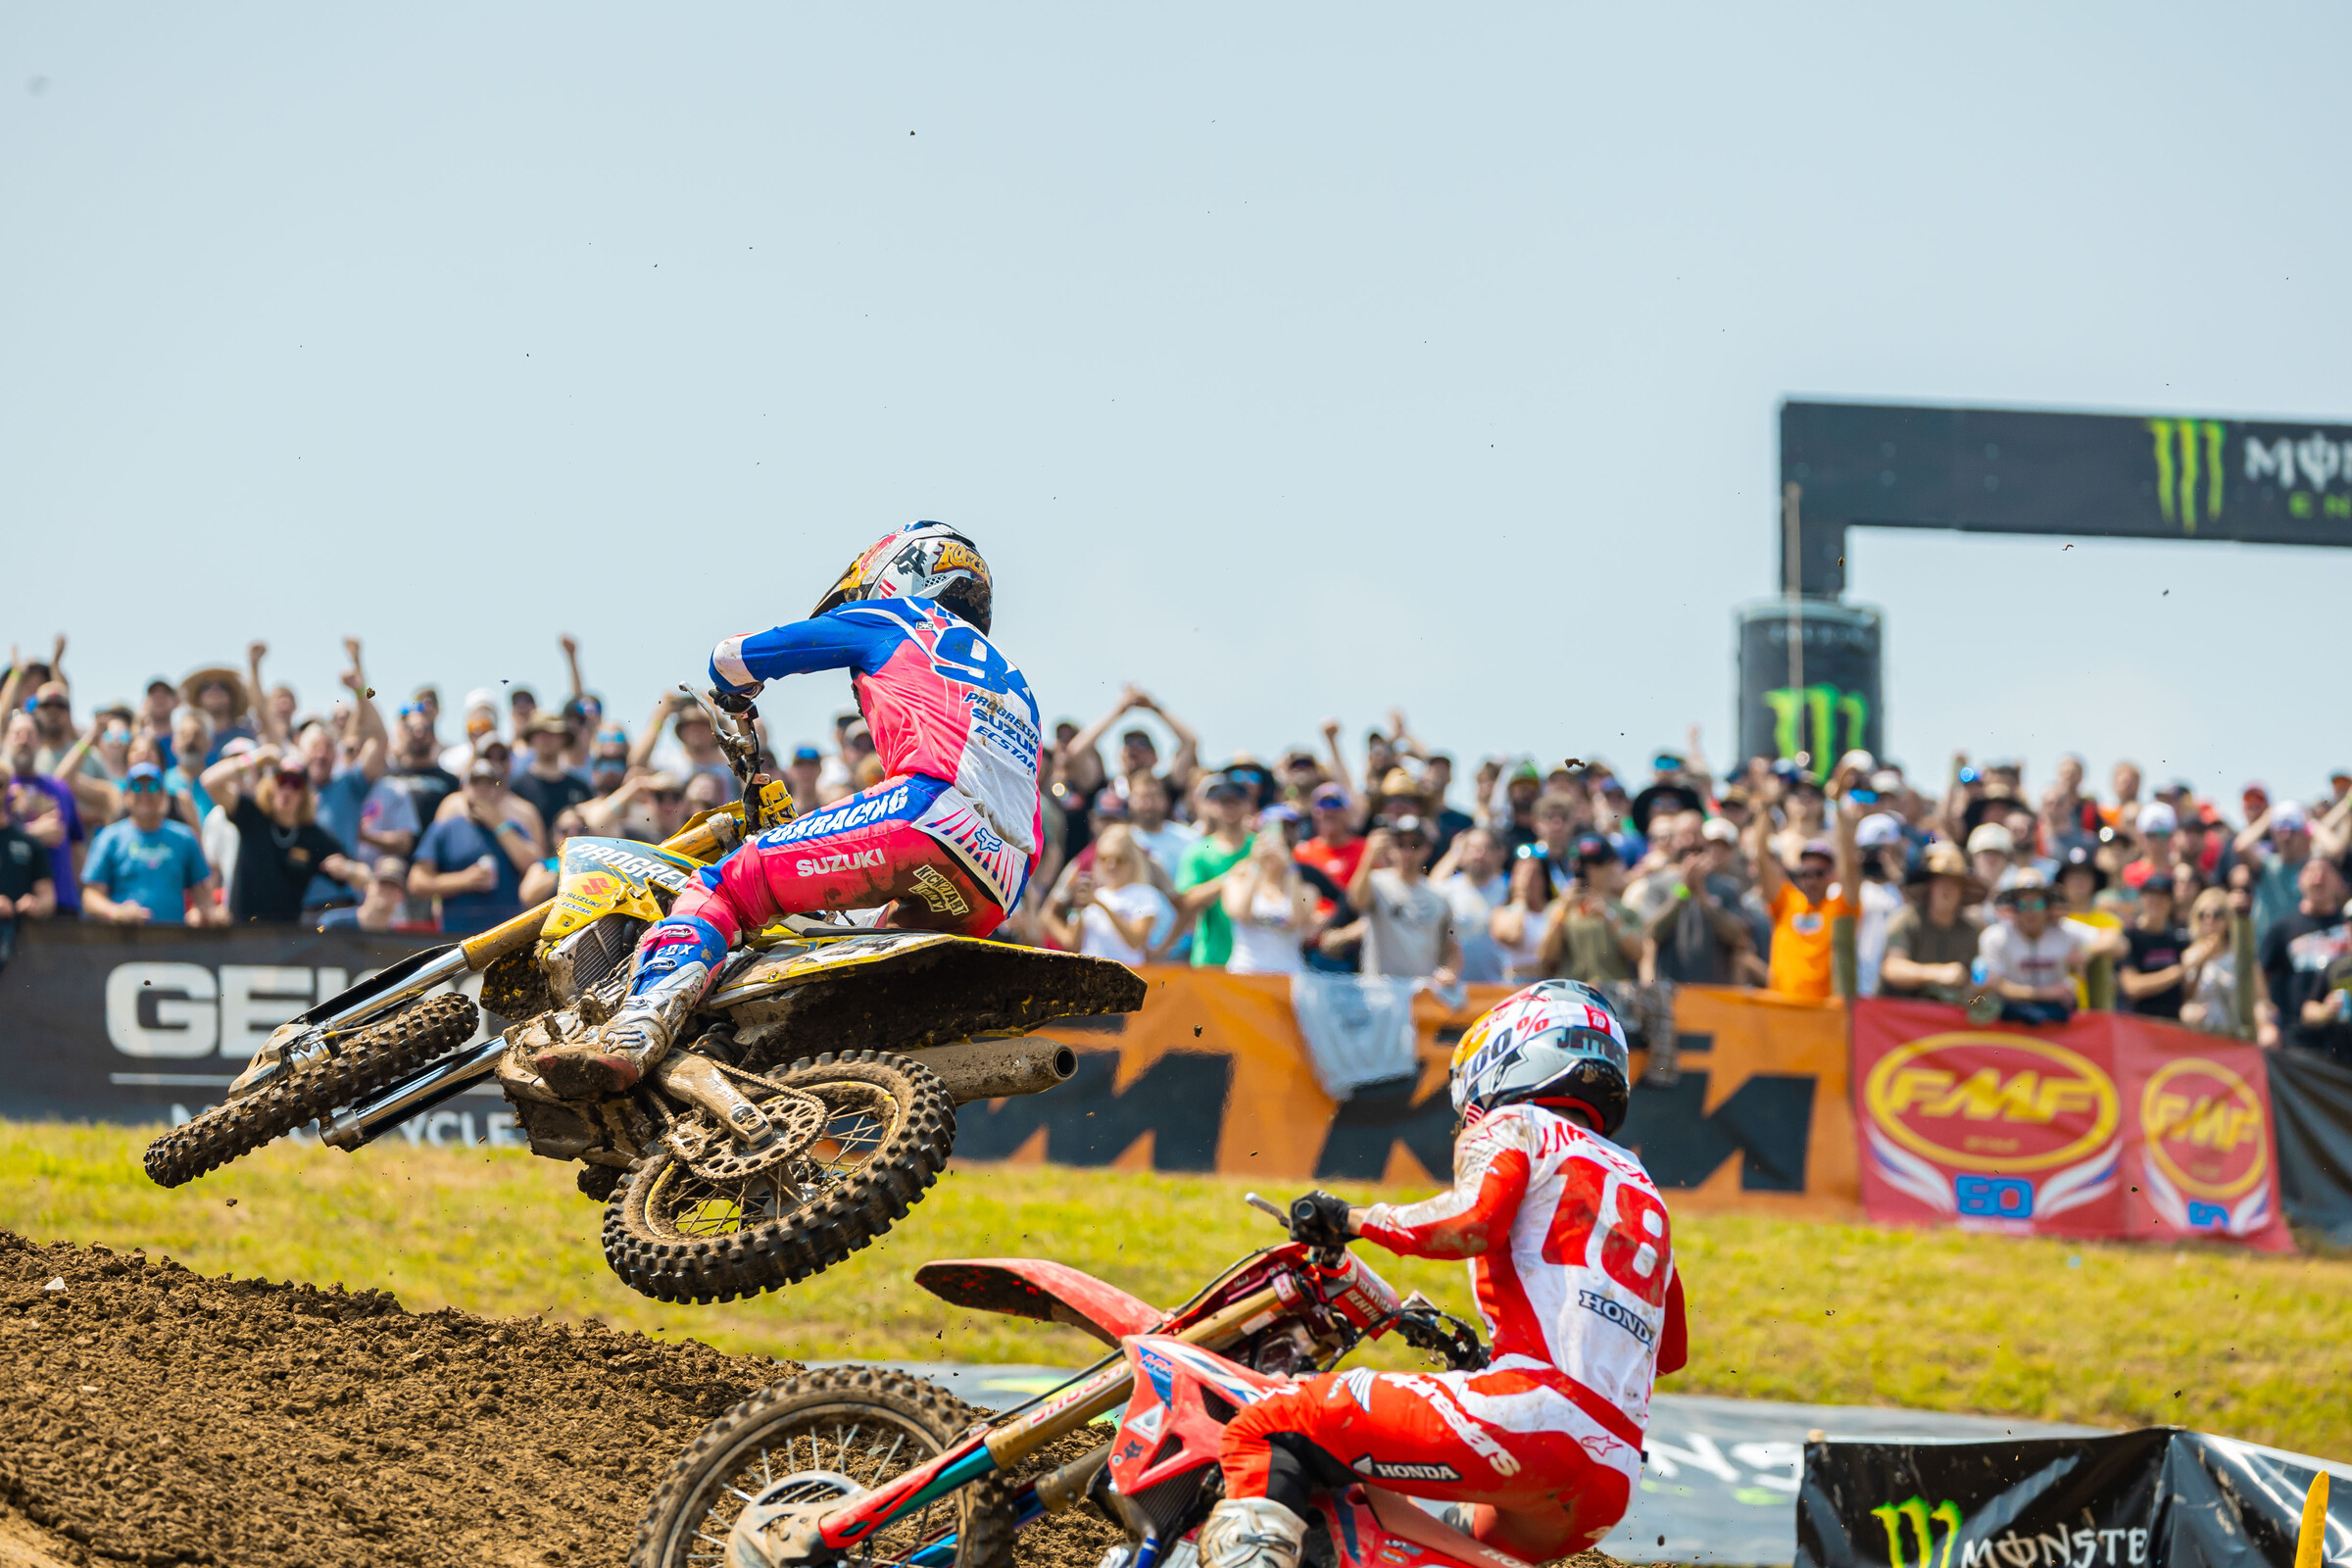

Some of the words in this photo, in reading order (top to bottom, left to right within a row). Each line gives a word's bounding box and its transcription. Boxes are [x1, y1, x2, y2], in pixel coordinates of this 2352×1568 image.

[797, 848, 885, 877] SUZUKI
[562, 902, 592, 915] ECSTAR
[565, 893, 602, 907] SUZUKI
[656, 945, 694, 957] FOX
[1889, 1067, 2097, 1125] FMF
[2156, 1092, 2259, 1152] FMF
[1542, 1155, 1671, 1308] 18
[1375, 1463, 1459, 1481] HONDA
